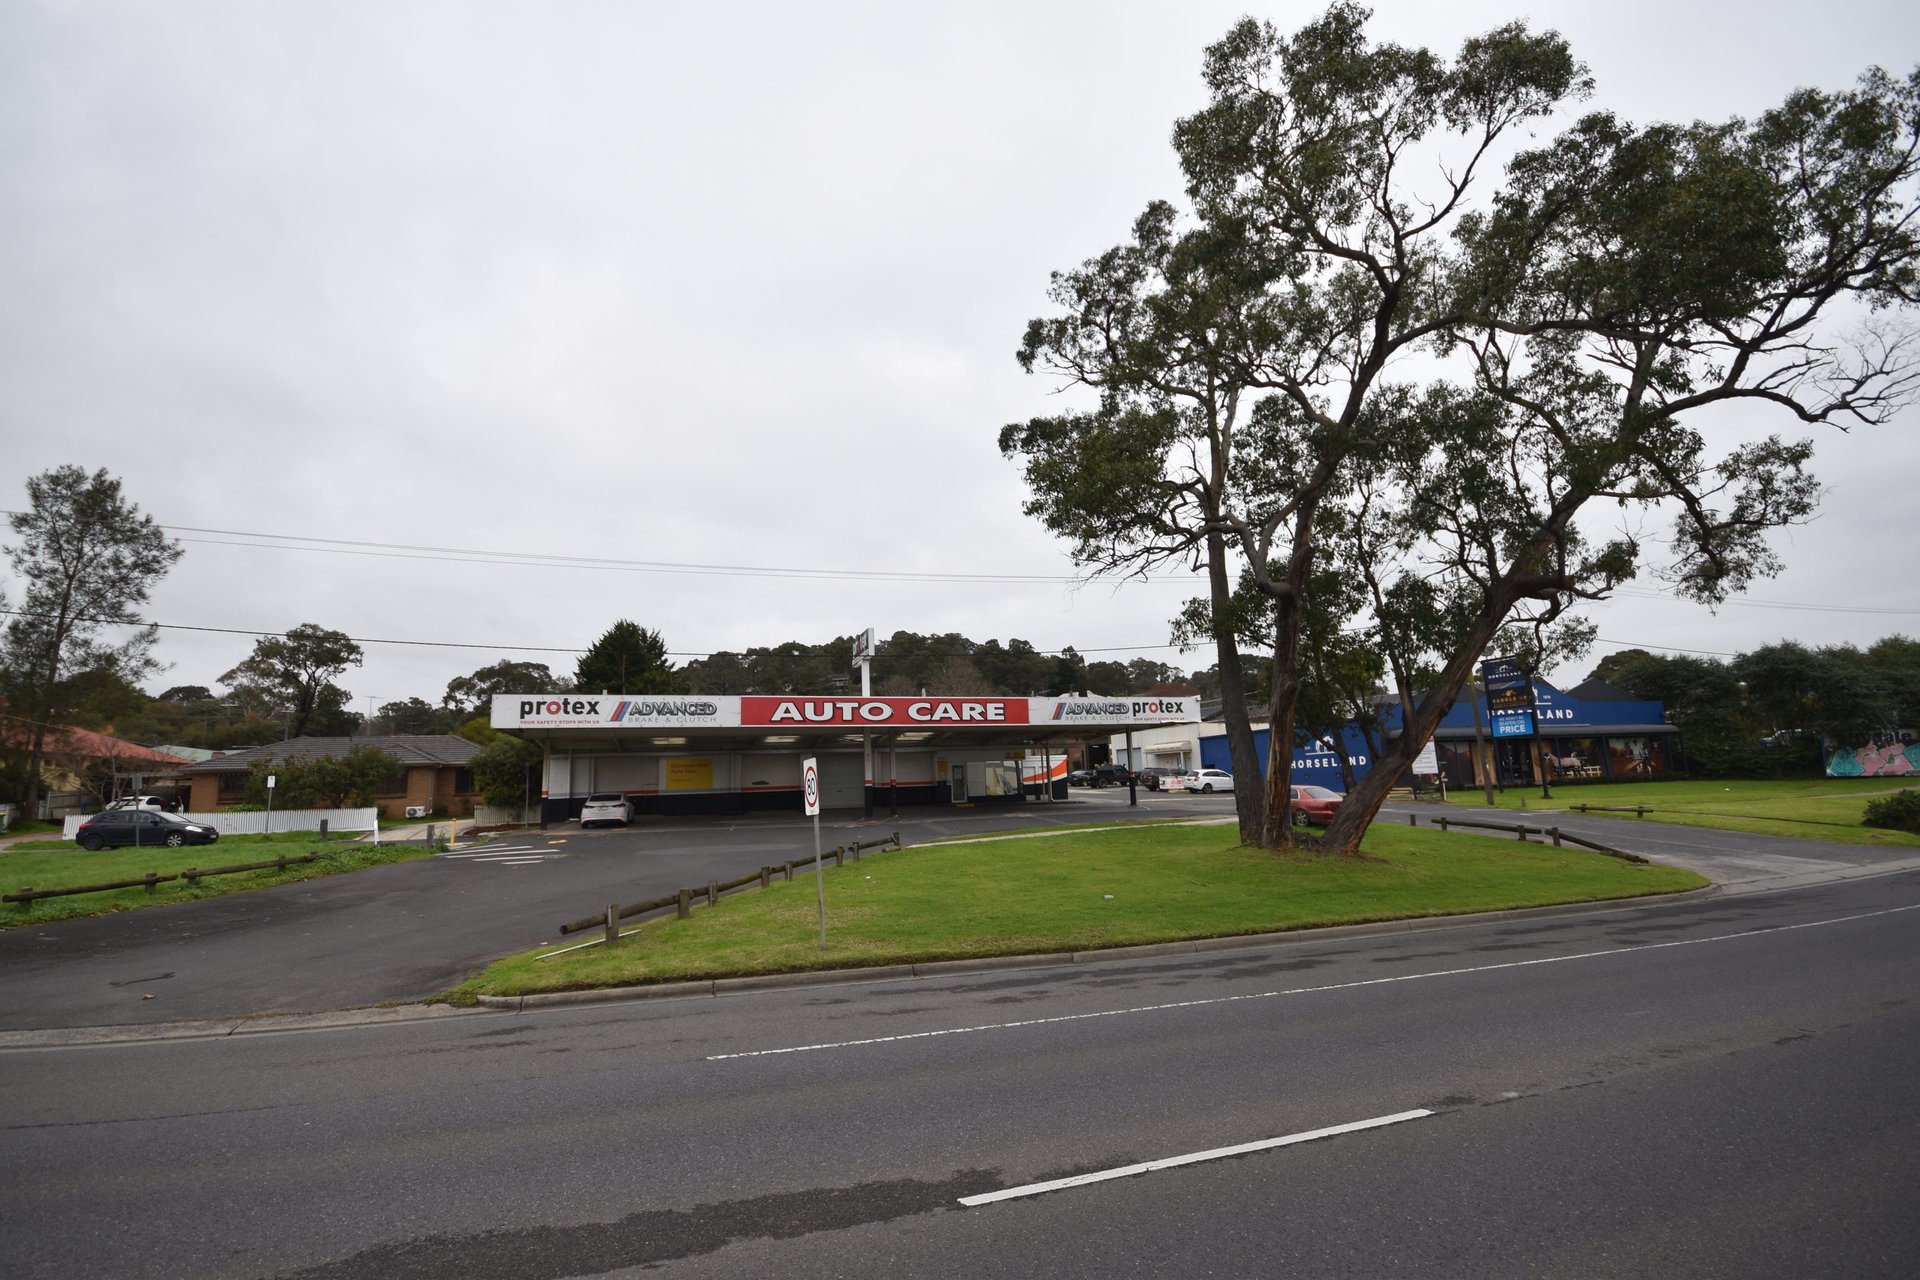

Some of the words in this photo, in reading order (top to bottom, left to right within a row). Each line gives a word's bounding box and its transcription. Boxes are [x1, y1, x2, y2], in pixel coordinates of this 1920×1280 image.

[520, 698, 600, 719] protex
[628, 701, 718, 716] ADVANCED
[770, 701, 895, 721] AUTO
[906, 701, 1006, 720] CARE
[1065, 702, 1130, 715] ADVANCED
[1132, 699, 1184, 716] protex
[1499, 724, 1526, 734] PRICE
[1290, 756, 1367, 769] HORSELND
[806, 777, 816, 796] 80
